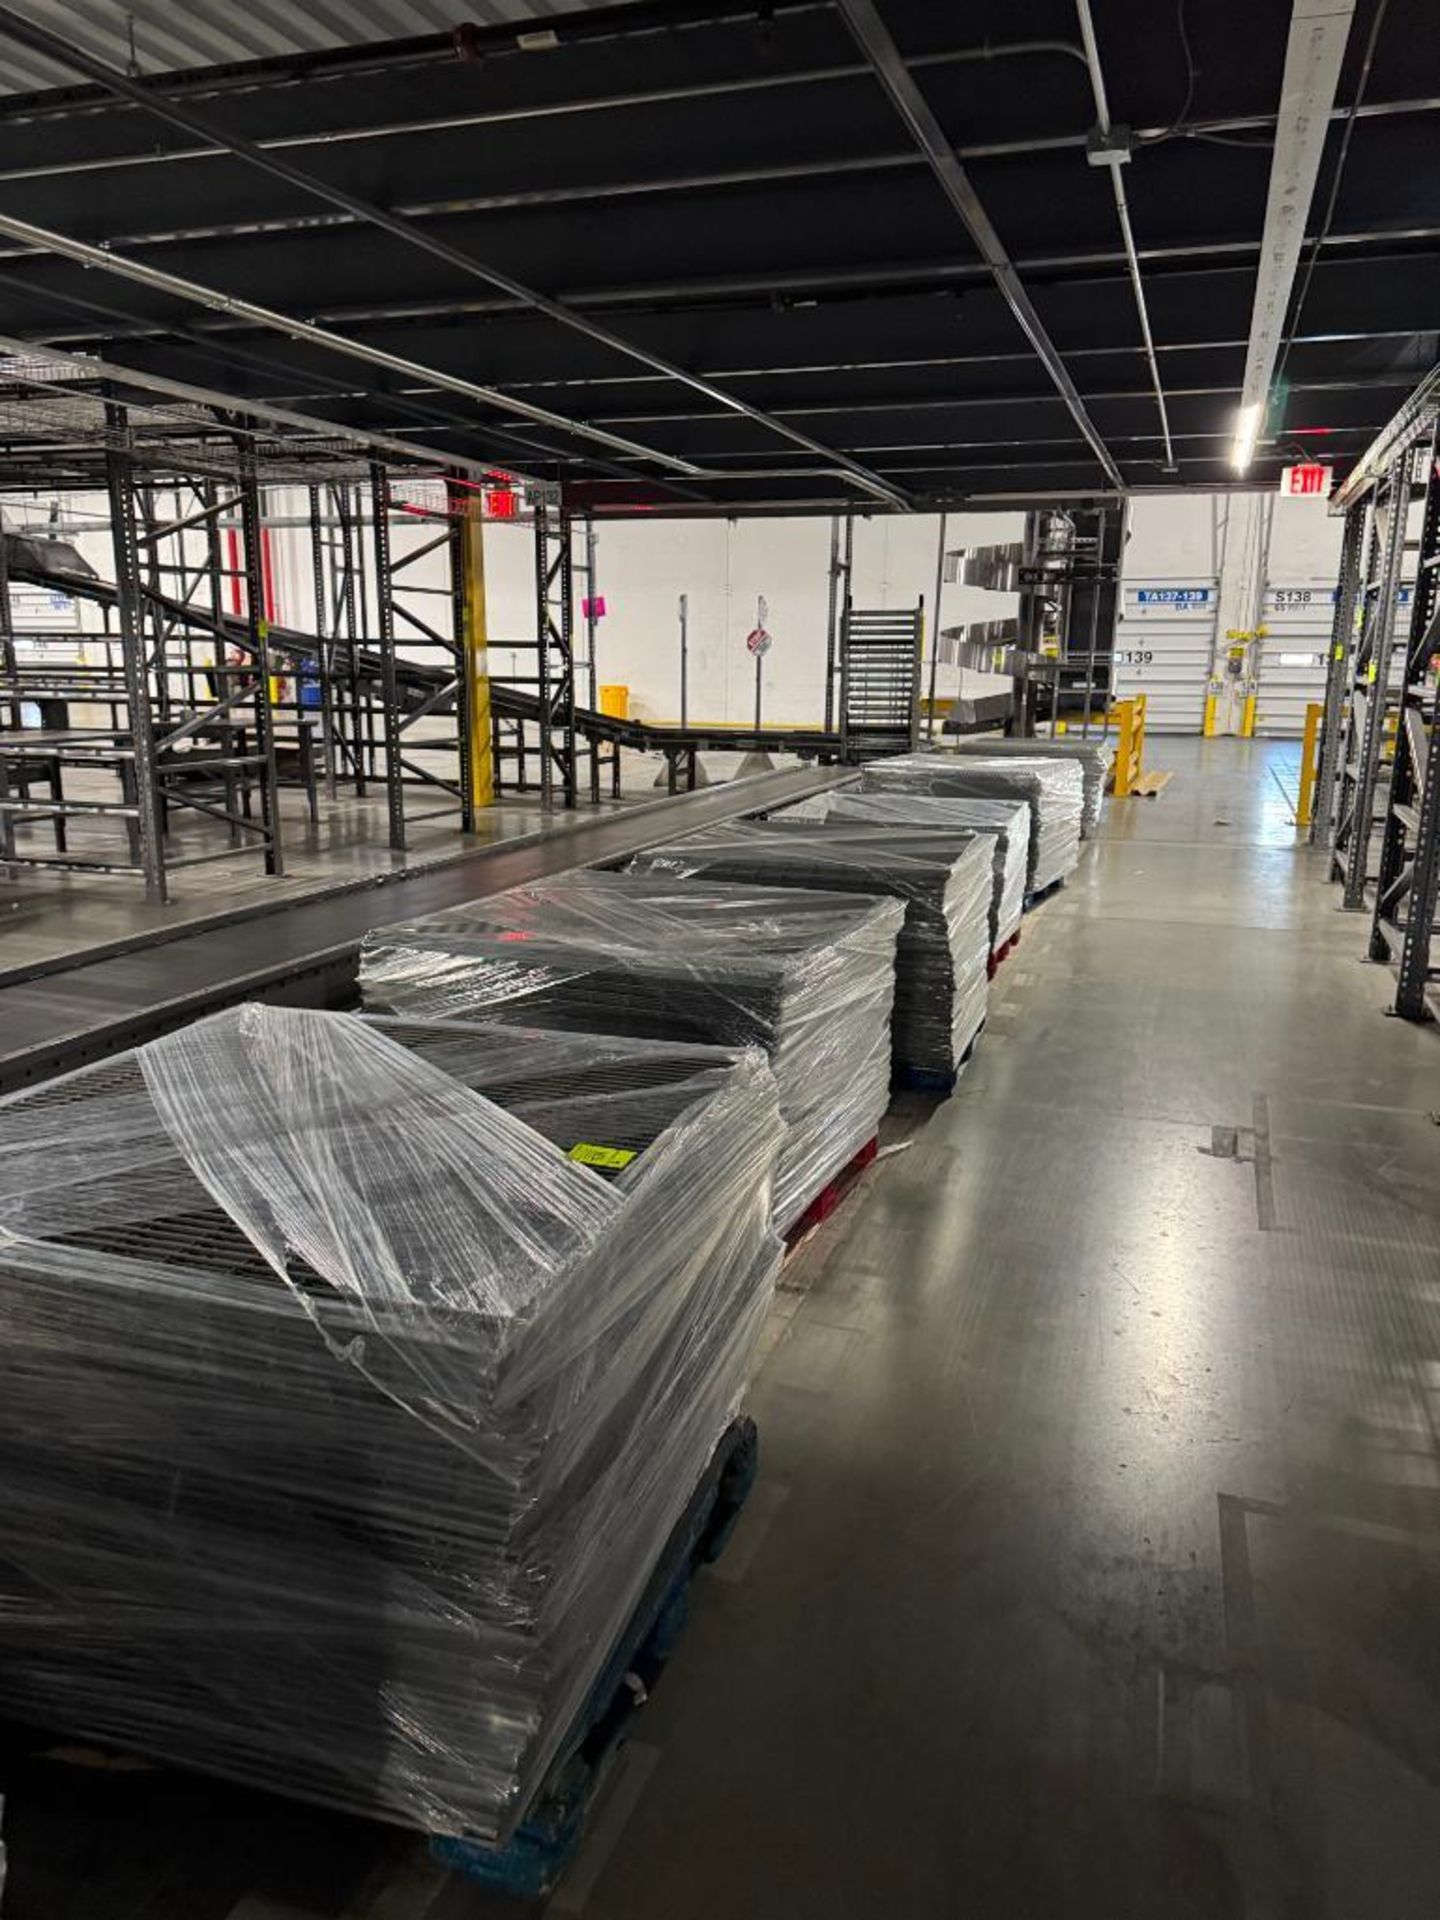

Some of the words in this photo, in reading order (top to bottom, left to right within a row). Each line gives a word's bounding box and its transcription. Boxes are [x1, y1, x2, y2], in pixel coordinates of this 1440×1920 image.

[1290, 467, 1325, 494] EXIT
[1275, 591, 1312, 602] S138
[1126, 651, 1153, 663] 139
